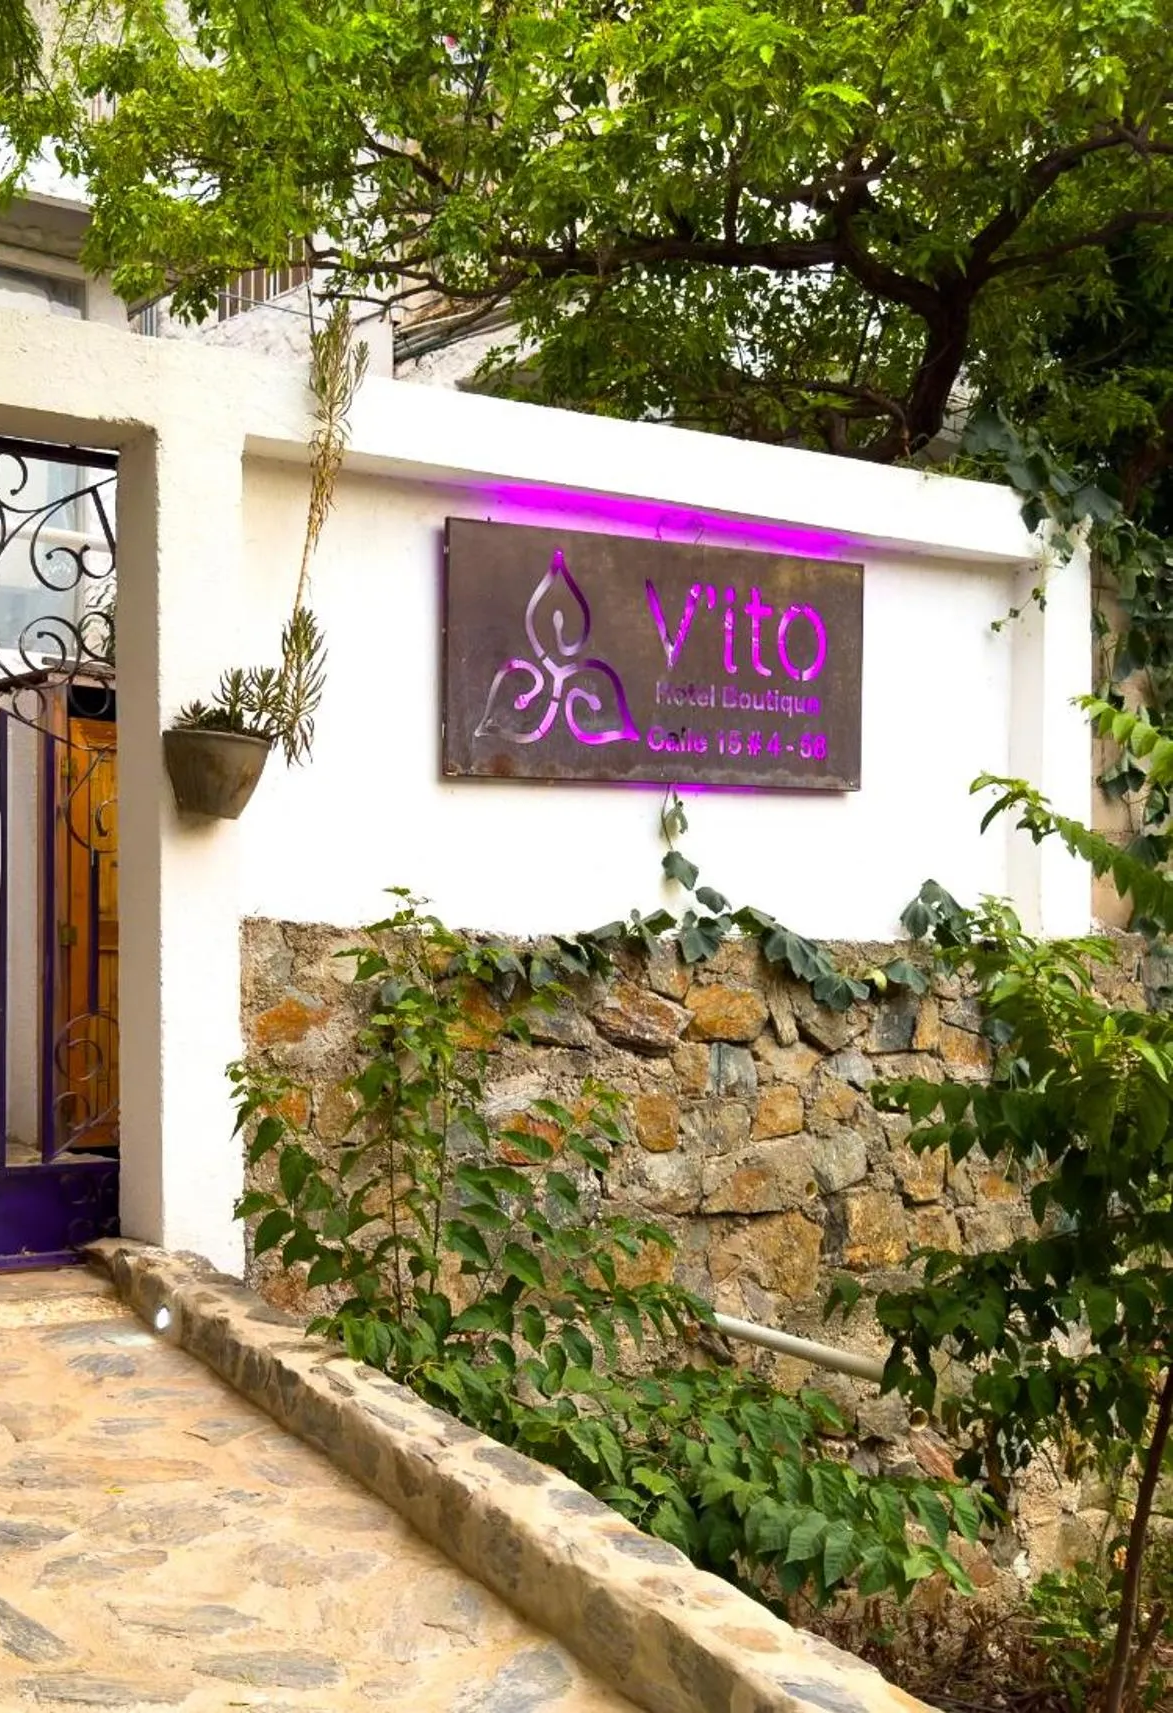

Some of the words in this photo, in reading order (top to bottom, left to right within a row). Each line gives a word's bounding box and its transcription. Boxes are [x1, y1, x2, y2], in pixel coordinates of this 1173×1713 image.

[645, 577, 827, 682] V'ito
[655, 680, 715, 708] Hotel
[722, 686, 821, 718] Boutique
[647, 725, 708, 754] Calle
